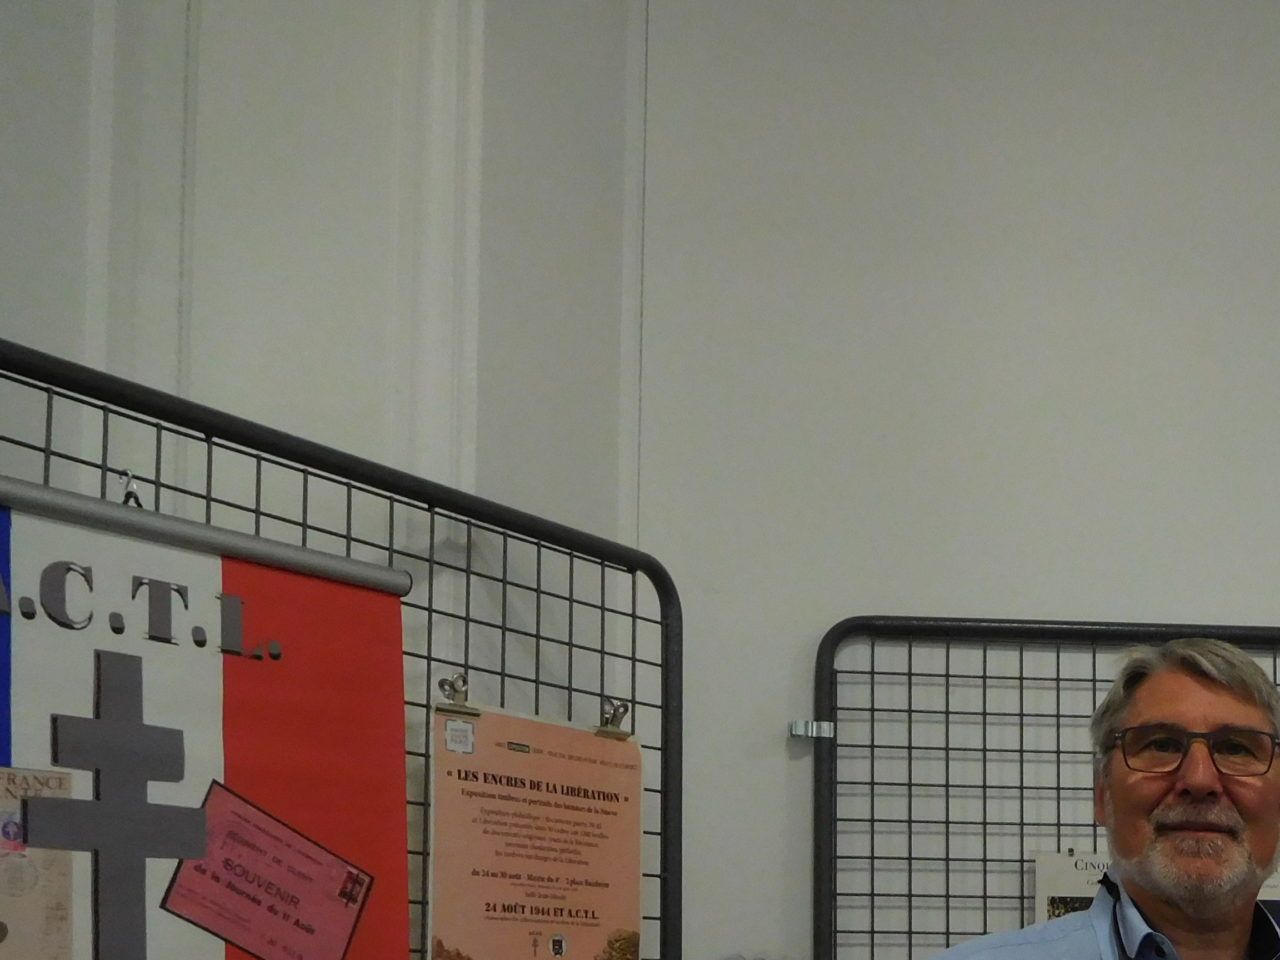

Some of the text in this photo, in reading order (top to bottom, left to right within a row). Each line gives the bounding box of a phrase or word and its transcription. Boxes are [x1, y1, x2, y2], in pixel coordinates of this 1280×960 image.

[0, 560, 282, 661] .C.T.L.
[0, 771, 69, 790] RANCE
[457, 768, 479, 783] LES
[483, 772, 526, 789] ENCRES
[529, 778, 543, 792] DE
[546, 781, 558, 794] LA
[560, 782, 620, 803] LIBÉRATION
[193, 863, 207, 876] de
[210, 870, 220, 884] la
[225, 877, 262, 907] Journée
[266, 903, 279, 917] du
[222, 857, 301, 909] SOUVENIR
[484, 901, 600, 920] 24 AOÛT 1944 ET A.C.T.L.
